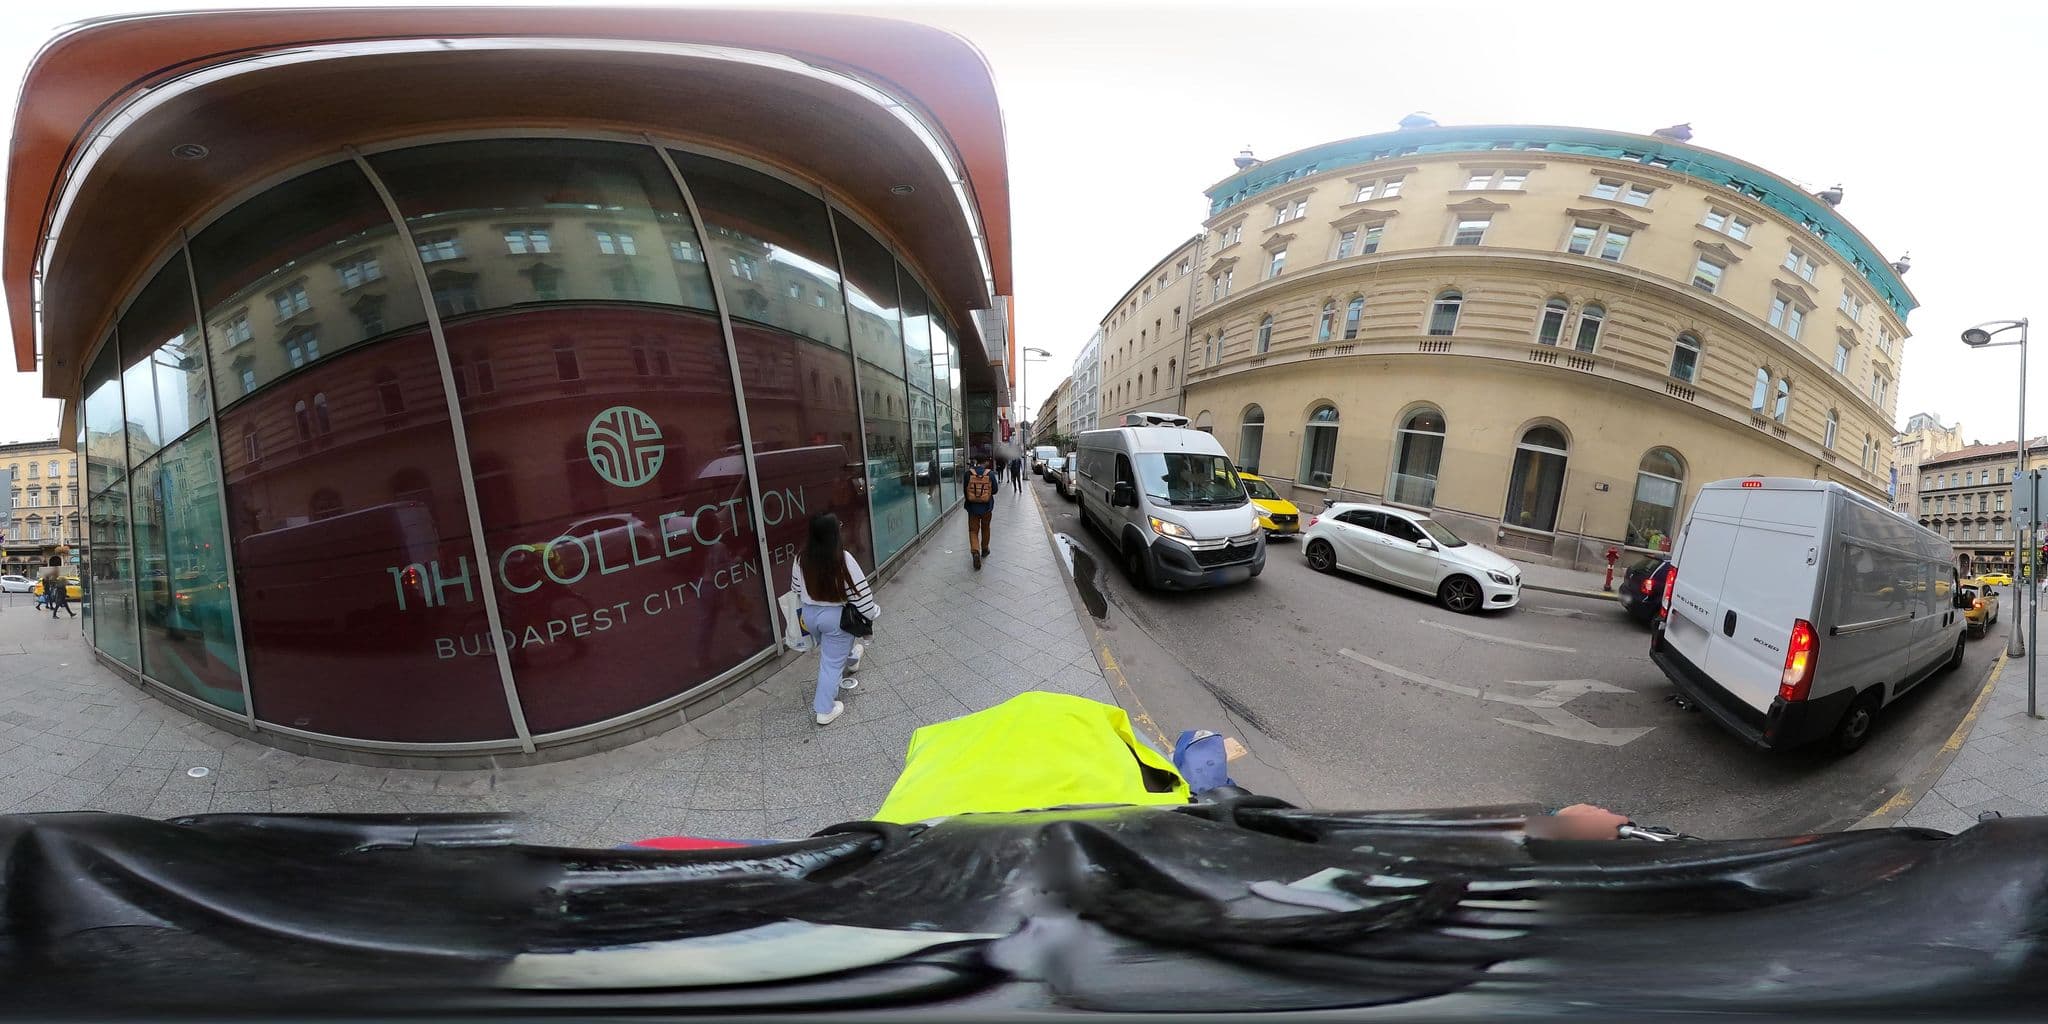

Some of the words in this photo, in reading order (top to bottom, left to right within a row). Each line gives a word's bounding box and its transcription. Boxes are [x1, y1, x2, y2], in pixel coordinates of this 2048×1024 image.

[500, 485, 806, 593] COLLECTION
[434, 601, 631, 660] BUDAPEST
[643, 577, 704, 615] CITY
[714, 542, 797, 590] CENER
[1676, 593, 1710, 616] PEUGEOT
[1753, 637, 1780, 653] BOXER
